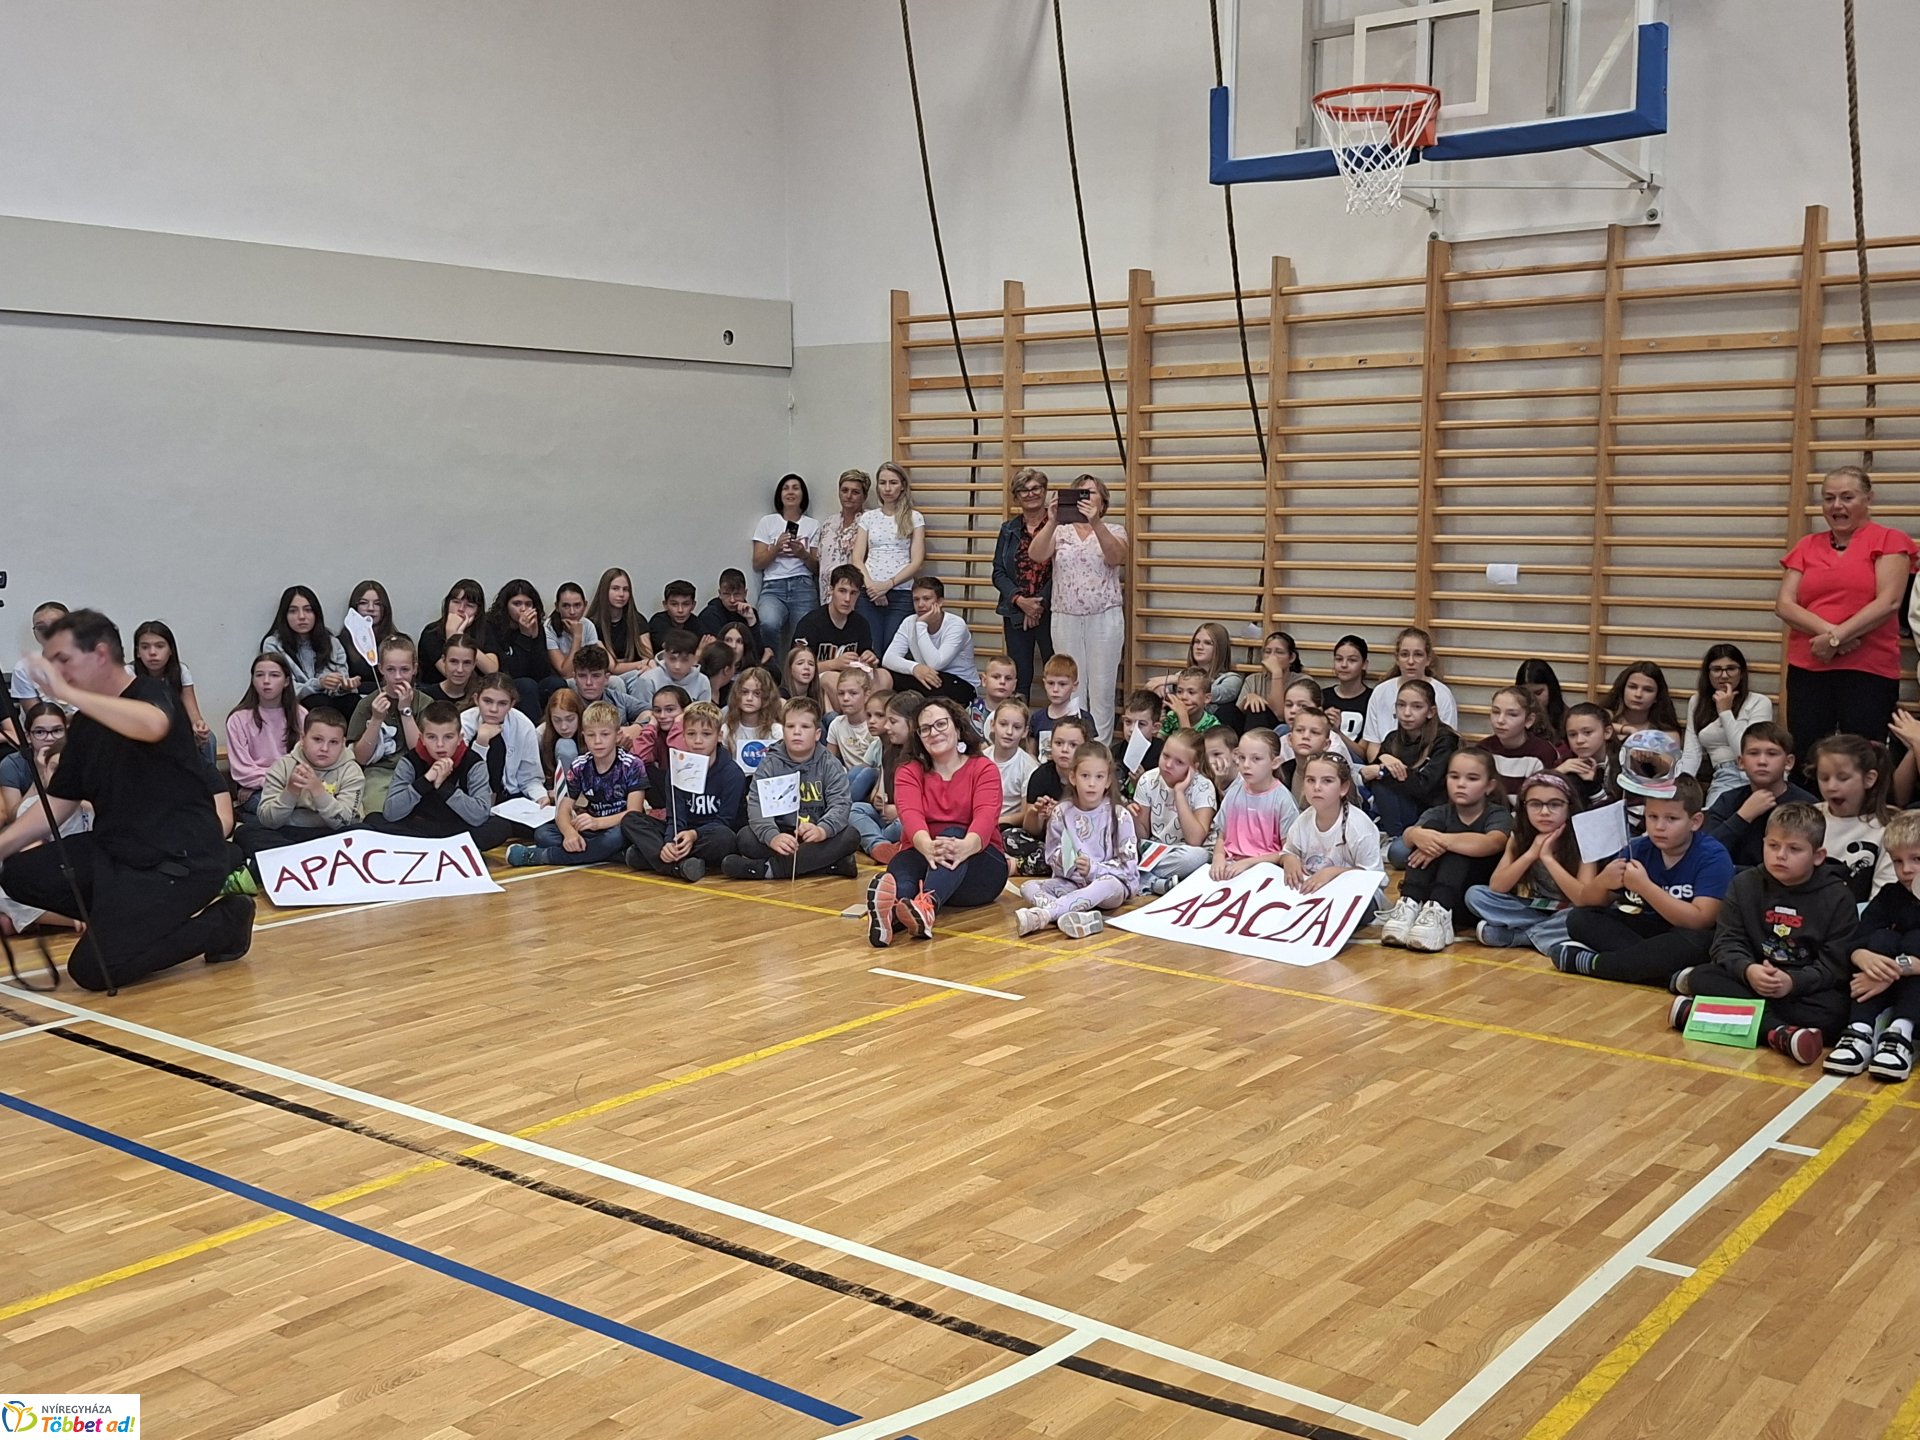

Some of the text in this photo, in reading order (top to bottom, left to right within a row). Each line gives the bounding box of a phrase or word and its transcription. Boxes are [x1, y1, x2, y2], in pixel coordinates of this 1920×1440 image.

[743, 750, 767, 758] NASA
[274, 837, 483, 892] APÁCZAI
[1144, 877, 1363, 947] APÁCZAI
